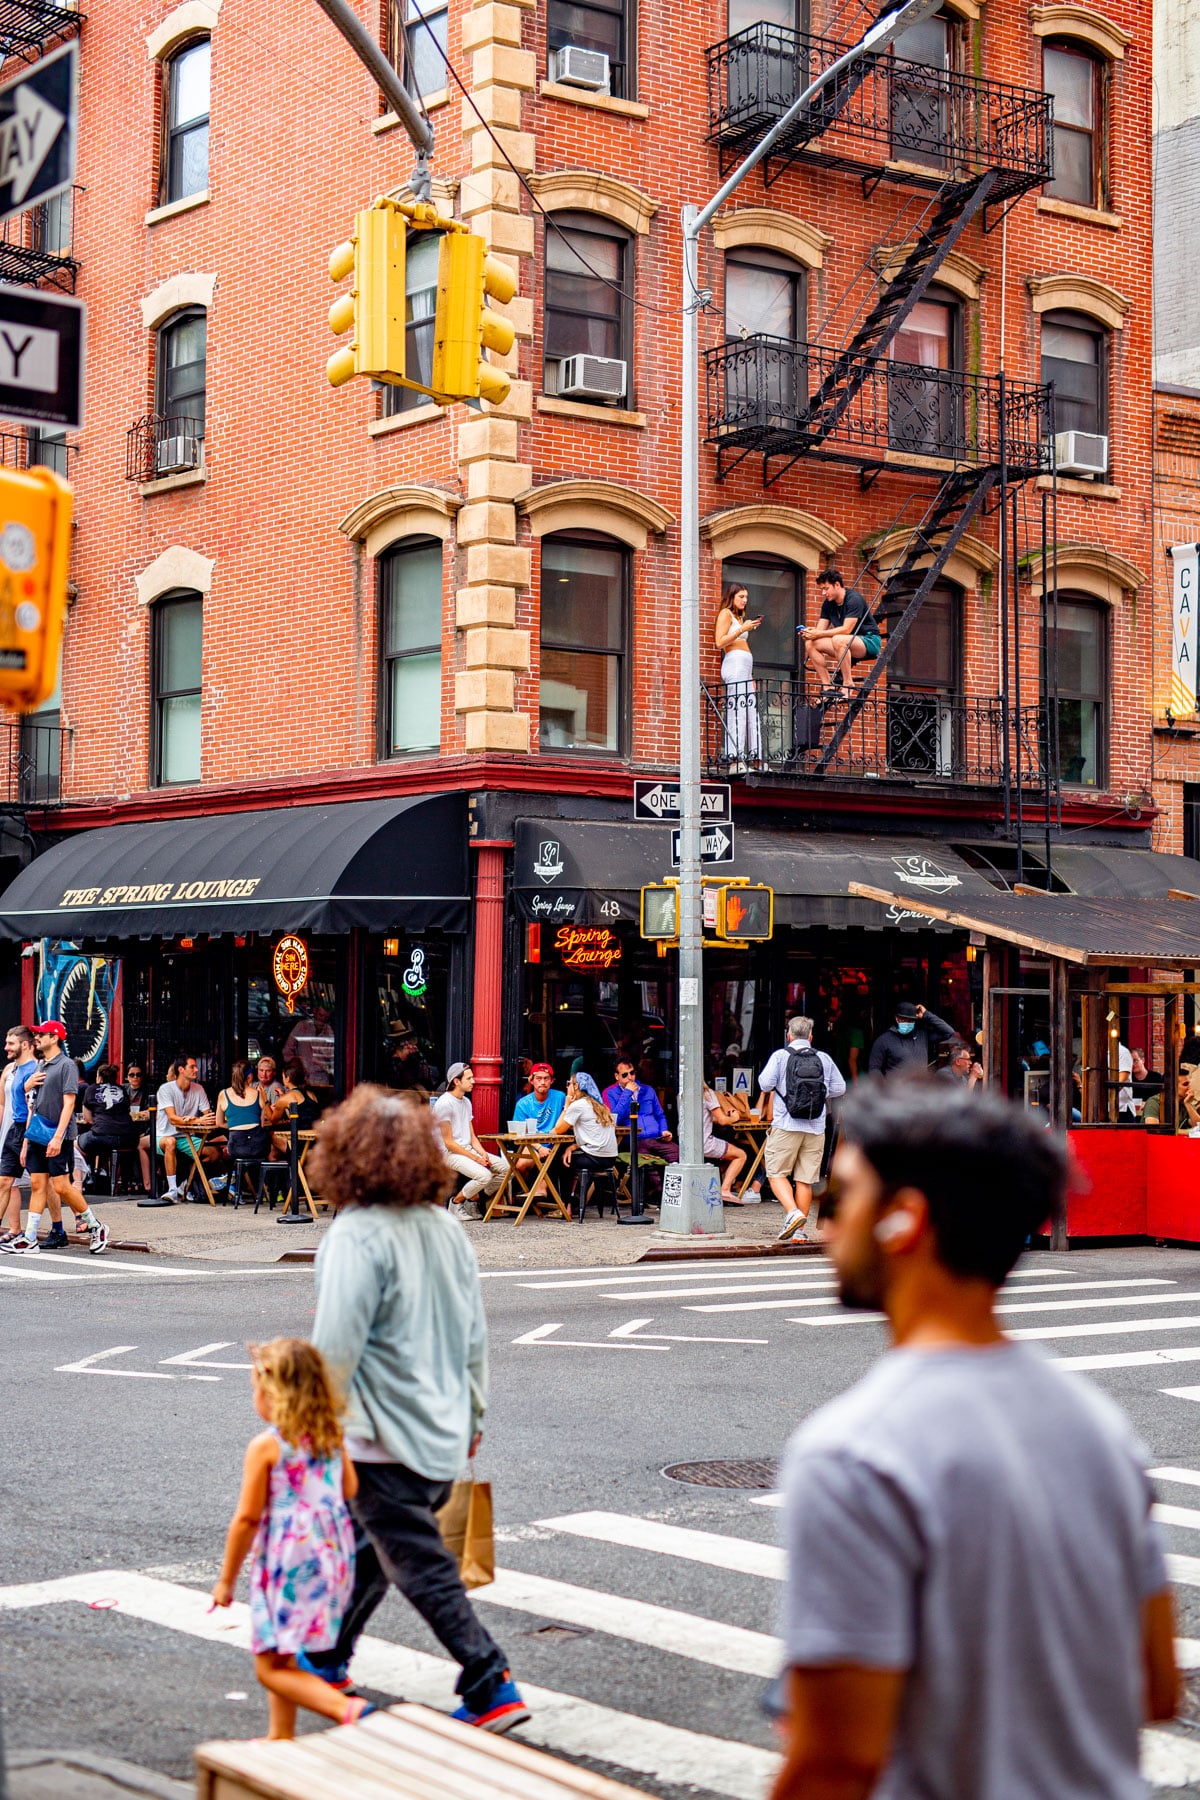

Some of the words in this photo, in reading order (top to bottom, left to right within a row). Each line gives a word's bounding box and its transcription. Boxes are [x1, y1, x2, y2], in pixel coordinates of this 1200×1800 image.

[0, 109, 42, 178] AY
[1179, 567, 1191, 663] CAVA
[650, 793, 677, 808] ONE
[700, 795, 718, 810] AY
[705, 836, 724, 851] WAY
[59, 887, 102, 906] THE
[98, 883, 174, 905] SPRING
[172, 878, 261, 900] LOUNGE
[532, 895, 553, 916] Spring
[553, 896, 575, 916] Lounge
[600, 901, 620, 916] 48
[554, 927, 612, 950] Spring
[285, 953, 296, 962] SIN
[292, 939, 307, 962] HARD
[564, 948, 622, 967] Lounge
[281, 962, 299, 971] HERE
[292, 966, 307, 990] CIDER
[735, 1071, 748, 1089] A
